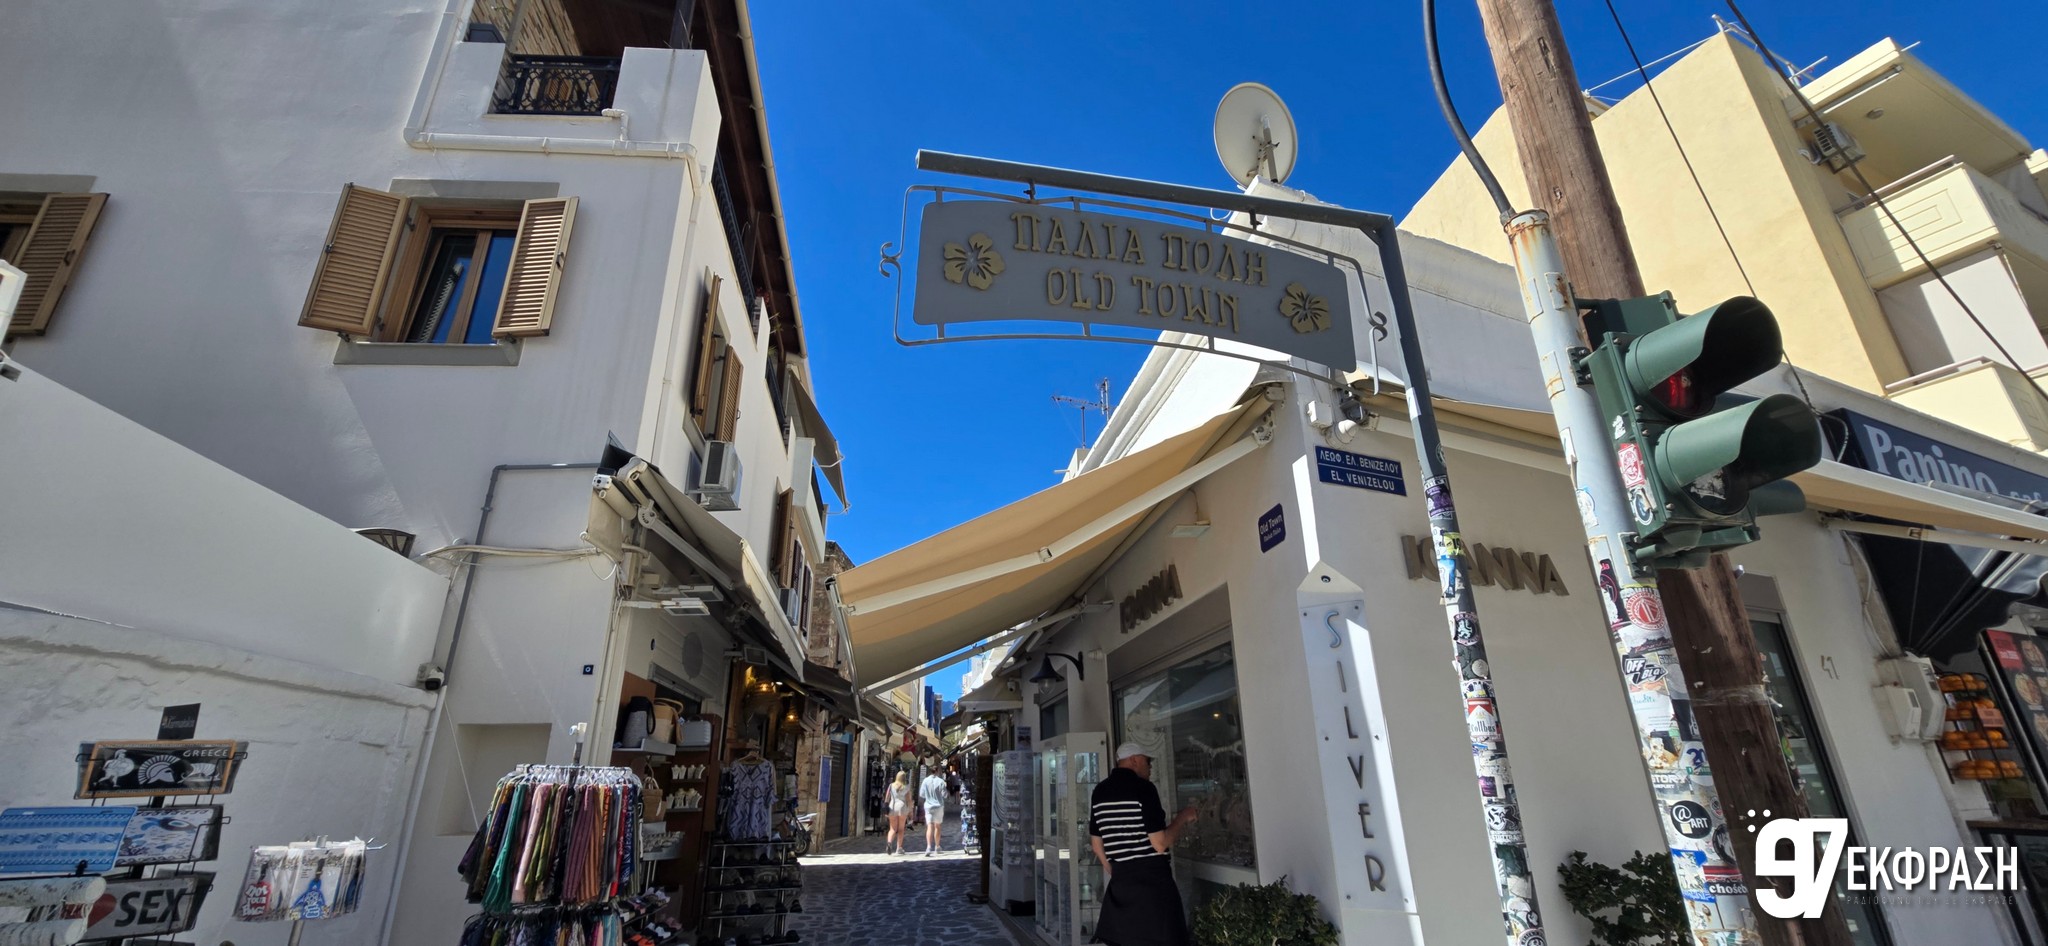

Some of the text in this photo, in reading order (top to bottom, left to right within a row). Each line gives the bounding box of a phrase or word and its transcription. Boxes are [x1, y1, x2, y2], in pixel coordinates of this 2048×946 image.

[1010, 212, 1270, 287] ΠΑΛΙΑ ΠΟΛΗ
[1046, 268, 1241, 334] OLD TOWN
[1359, 457, 1399, 474] ΒΕΝΙΖΕΛΟΥ
[1863, 423, 1999, 496] Panino
[1330, 470, 1395, 491] EL. VENIZELOU
[1260, 514, 1283, 535] Old Town
[1626, 659, 1646, 674] OFF
[182, 749, 229, 757] GREECE
[1323, 609, 1387, 894] SILVER
[1690, 817, 1709, 829] ART
[114, 888, 188, 928] SEX
